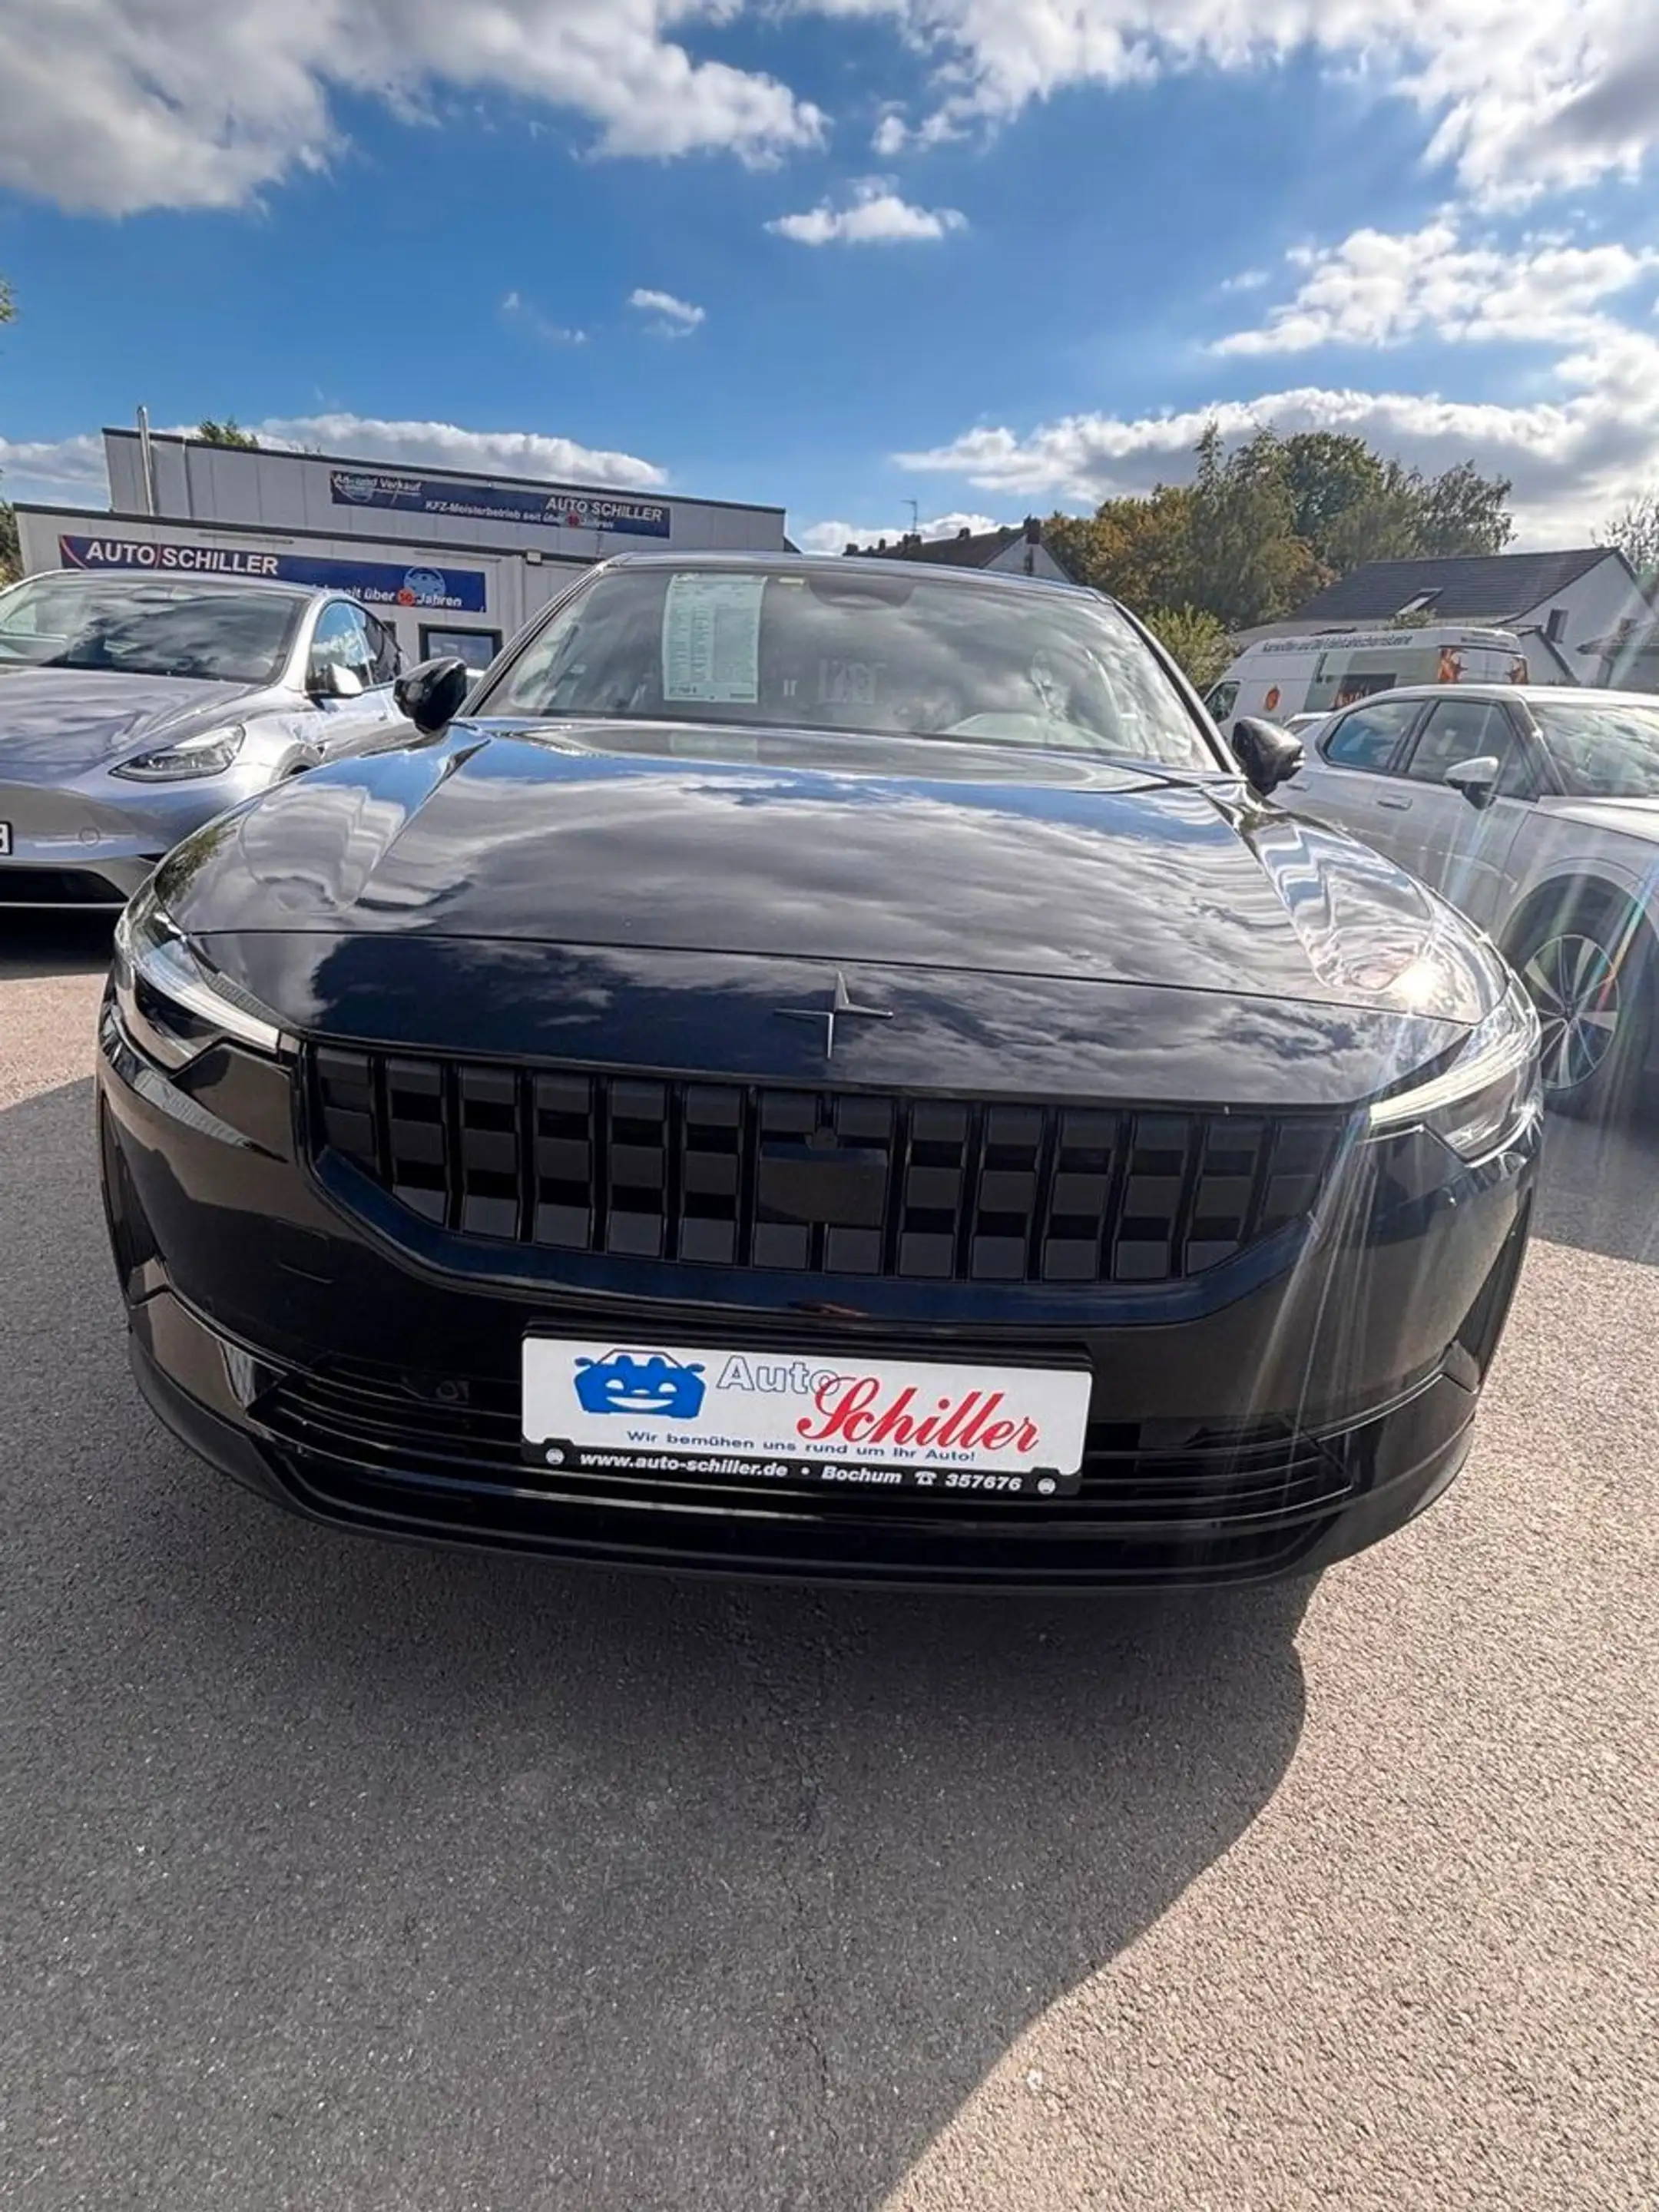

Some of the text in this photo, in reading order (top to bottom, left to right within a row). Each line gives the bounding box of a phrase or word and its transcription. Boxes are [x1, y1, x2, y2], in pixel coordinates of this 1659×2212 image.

[426, 501, 520, 520] KFZ-Meisterbetrieb
[545, 497, 588, 513] AUTO
[591, 503, 663, 522] SCHILLER
[84, 541, 279, 576] AUTO SCHILLER
[363, 587, 396, 603] über
[416, 593, 462, 608] Jahren
[716, 1355, 1040, 1454] Auto Schiller
[627, 1430, 976, 1462] Wir bemühen uns rund um Ihr Auto!
[580, 1452, 1023, 1492] www.auto-schiller.de Bochum 357676
